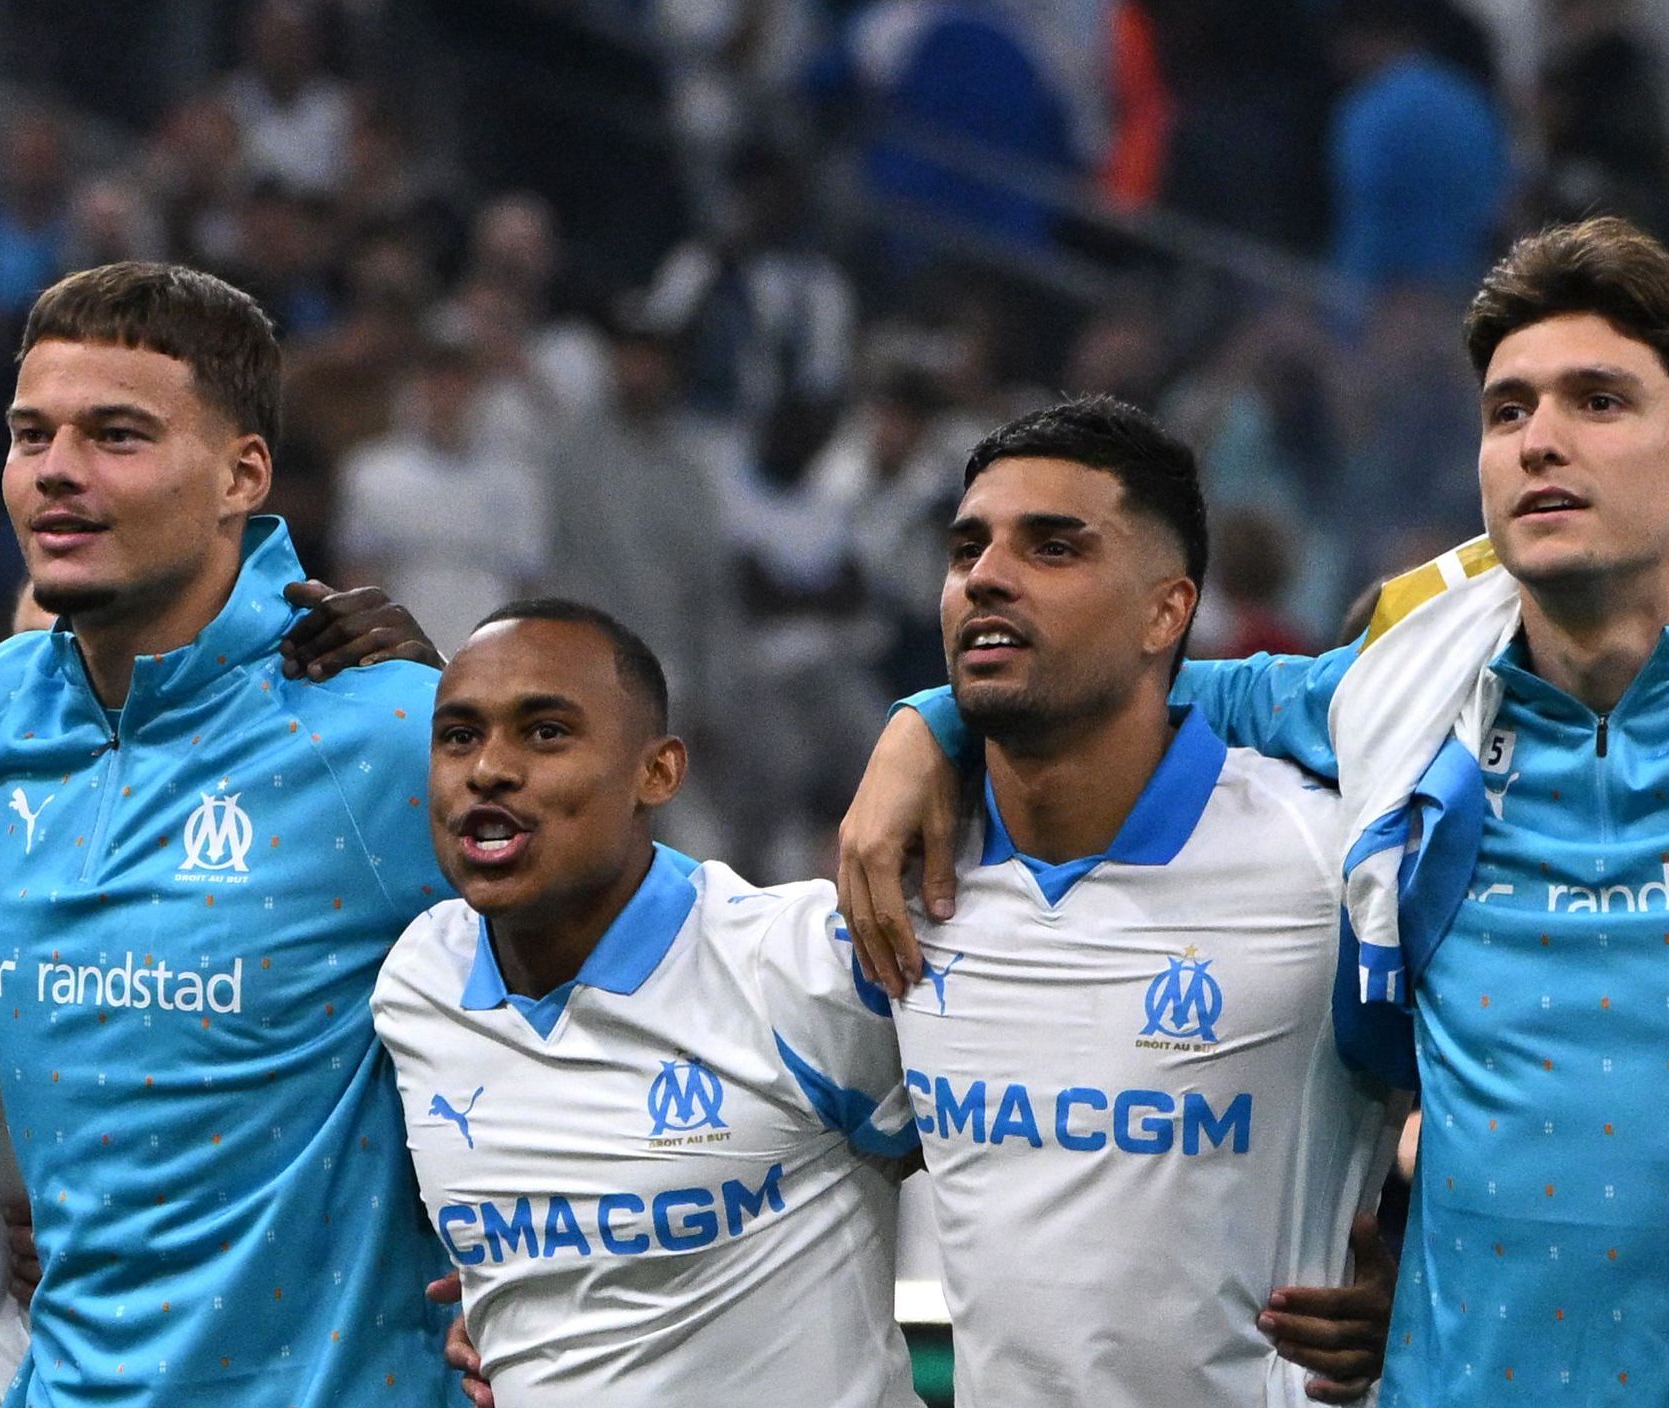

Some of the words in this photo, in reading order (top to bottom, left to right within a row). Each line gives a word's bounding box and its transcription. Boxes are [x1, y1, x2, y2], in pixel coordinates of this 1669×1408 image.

[1488, 736, 1505, 766] 5
[175, 874, 205, 883] DROIT
[208, 875, 224, 884] AU
[226, 876, 249, 884] BUT
[38, 952, 243, 1013] randstad
[1135, 1040, 1170, 1050] DROIT
[1173, 1042, 1190, 1051] AU
[906, 1068, 1043, 1148] CMA
[1055, 1087, 1253, 1155] CGM
[649, 1137, 684, 1149] DROIT
[687, 1135, 703, 1144] AU
[707, 1132, 731, 1142] BUT
[438, 1197, 591, 1265] CMA
[597, 1163, 786, 1255] CGM
